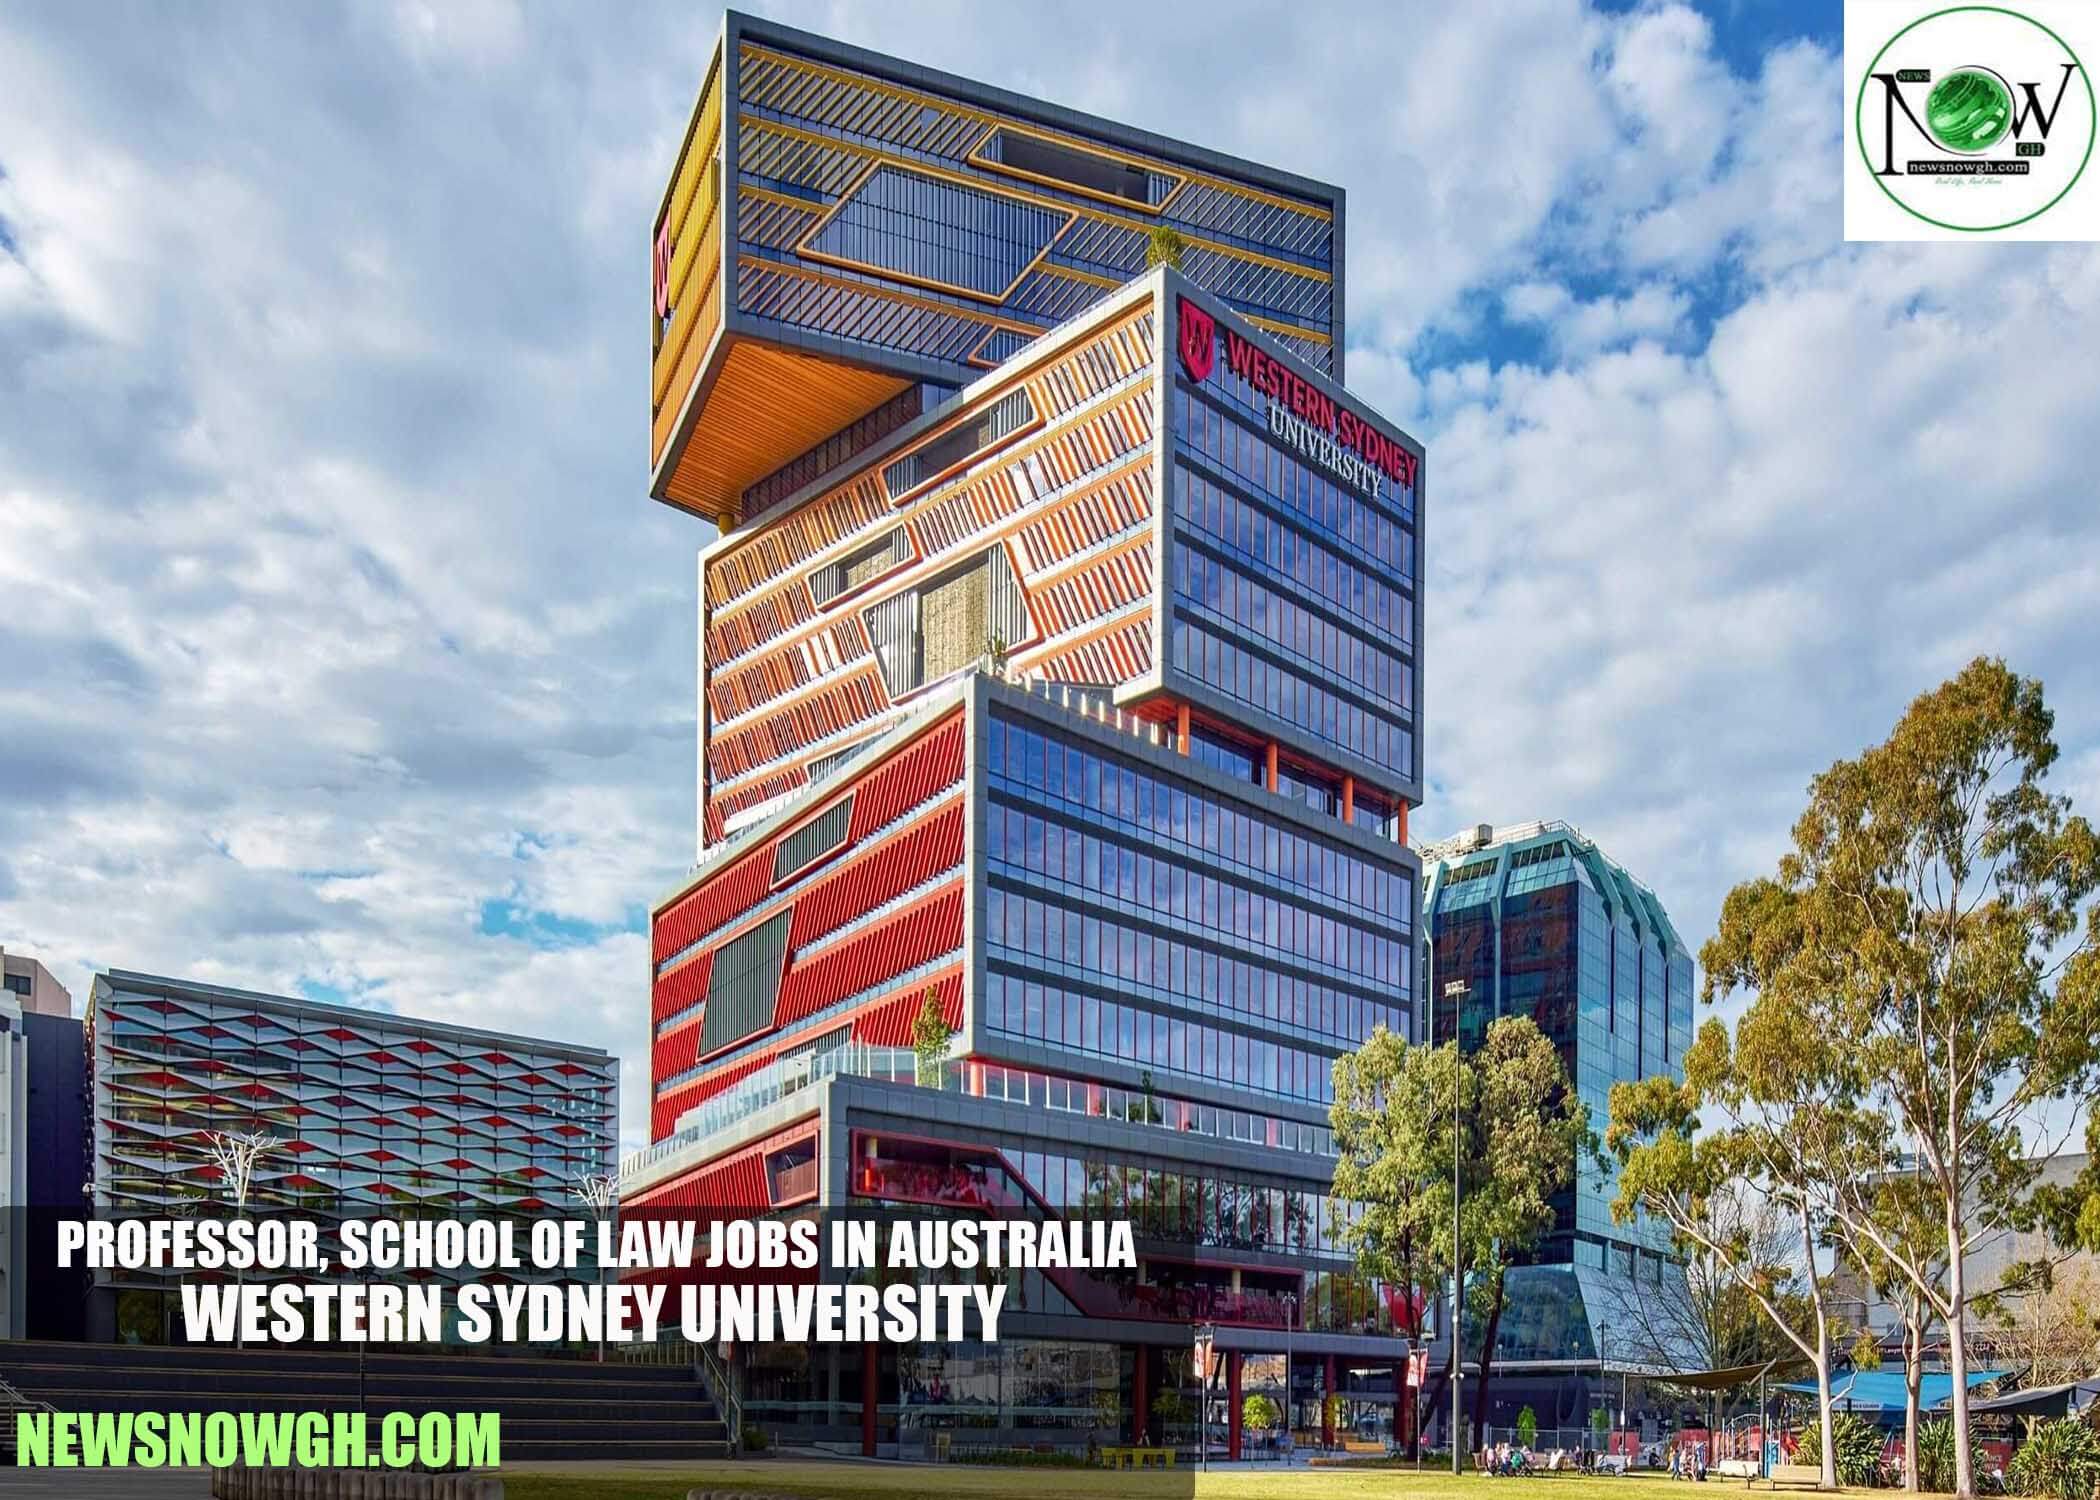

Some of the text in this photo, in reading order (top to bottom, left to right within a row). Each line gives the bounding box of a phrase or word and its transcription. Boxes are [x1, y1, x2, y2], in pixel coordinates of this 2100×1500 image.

[1228, 331, 1418, 489] WESTERN SYDNEY
[1269, 405, 1383, 498] UNIVERSITY
